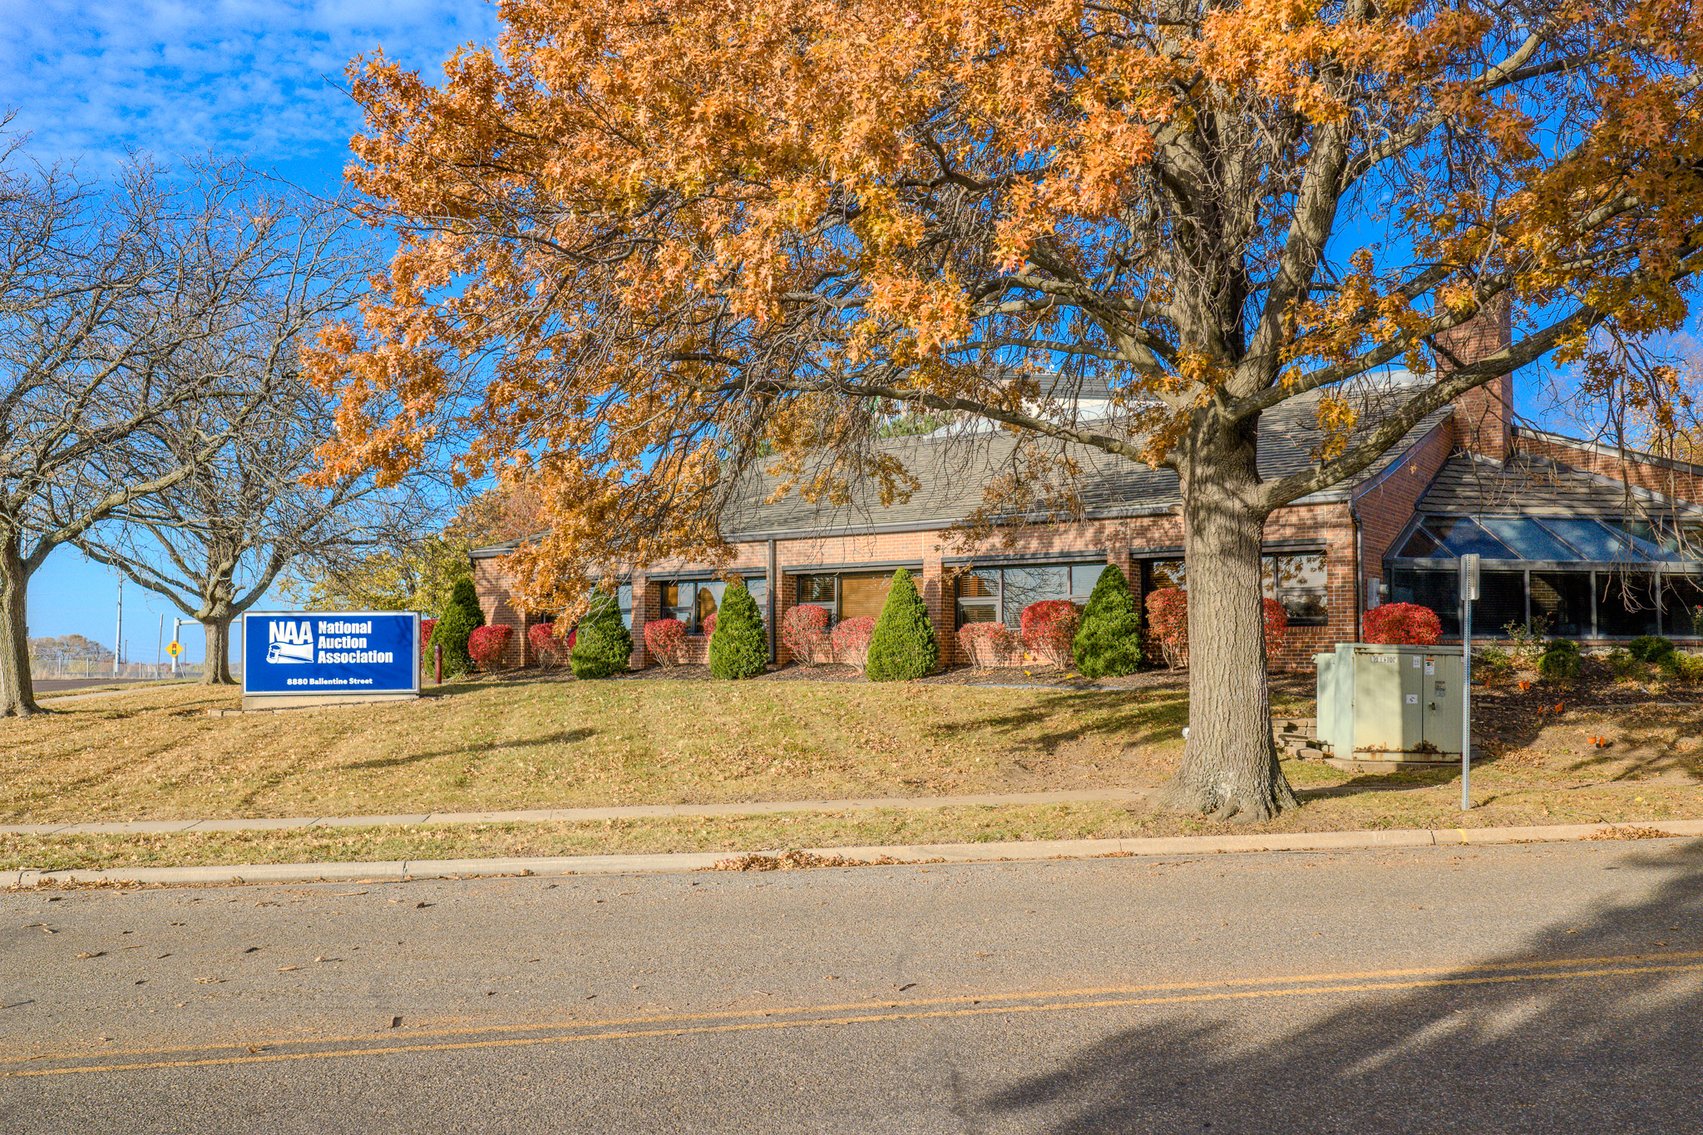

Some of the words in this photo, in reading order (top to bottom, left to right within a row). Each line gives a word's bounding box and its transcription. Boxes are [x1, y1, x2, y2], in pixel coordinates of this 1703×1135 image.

[269, 621, 313, 644] NAA
[318, 621, 372, 634] National
[318, 636, 367, 649] Auction
[318, 650, 393, 663] Association
